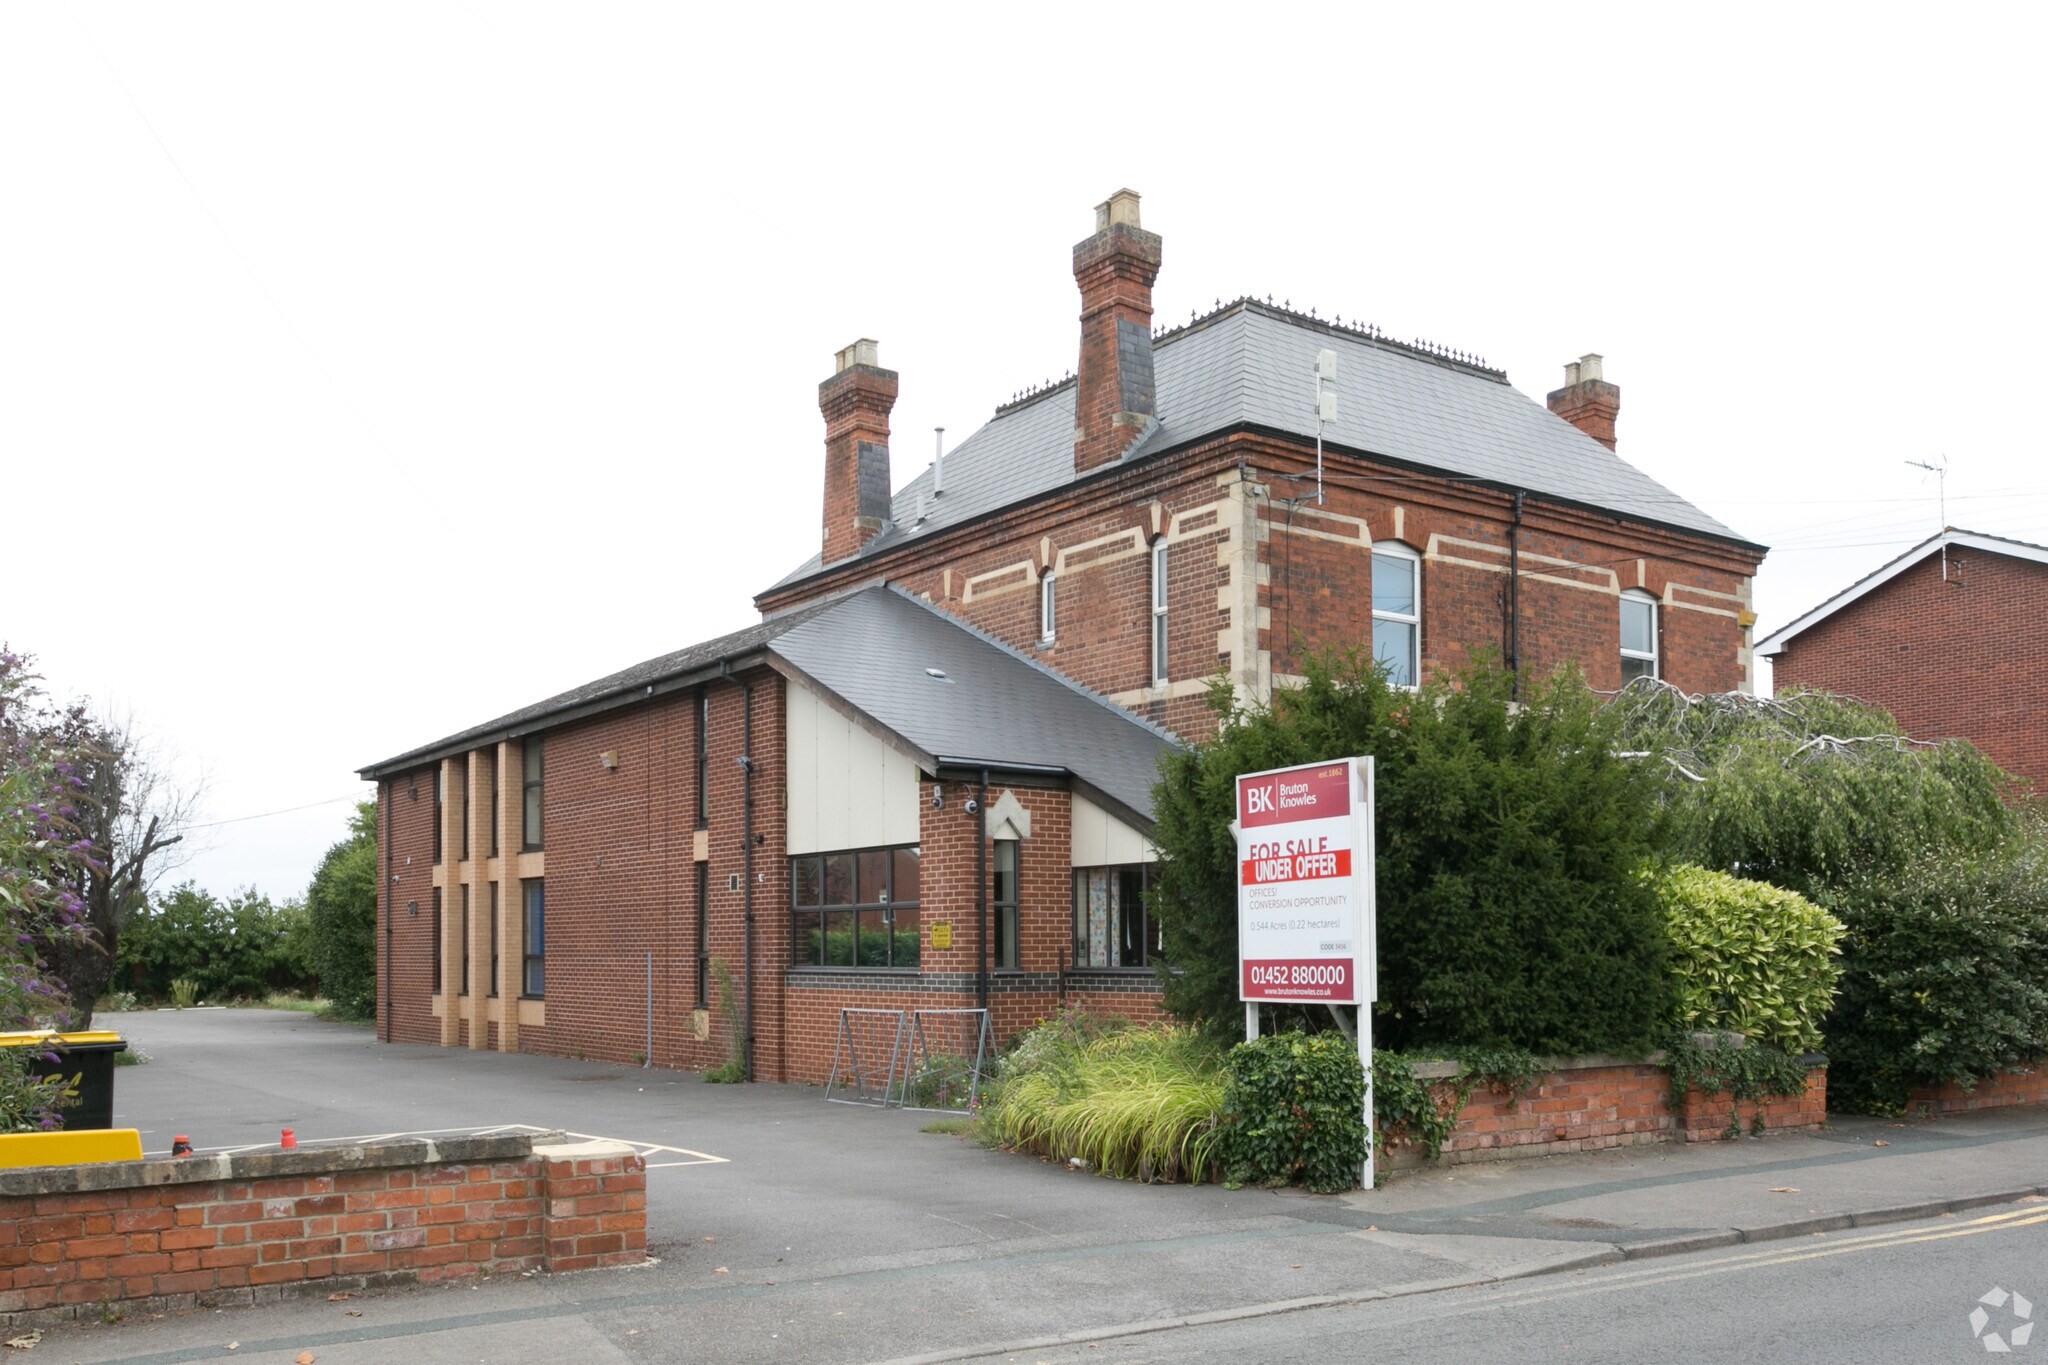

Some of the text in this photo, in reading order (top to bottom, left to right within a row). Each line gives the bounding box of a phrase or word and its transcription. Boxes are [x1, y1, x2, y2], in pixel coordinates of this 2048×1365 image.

[1280, 783, 1308, 796] Bruton
[1247, 785, 1275, 814] BK
[1280, 794, 1317, 808] Knowles
[1250, 837, 1327, 860] FOR SALE
[1255, 852, 1337, 882] UNDER OFFER
[1249, 887, 1278, 898] OFFICES/
[1249, 895, 1347, 910] CONVERSION OPPORTUNITY
[1270, 921, 1287, 930] Acres
[1251, 965, 1345, 985] 01452 880000
[1264, 987, 1332, 996] www.brutonknowles.co.uk
